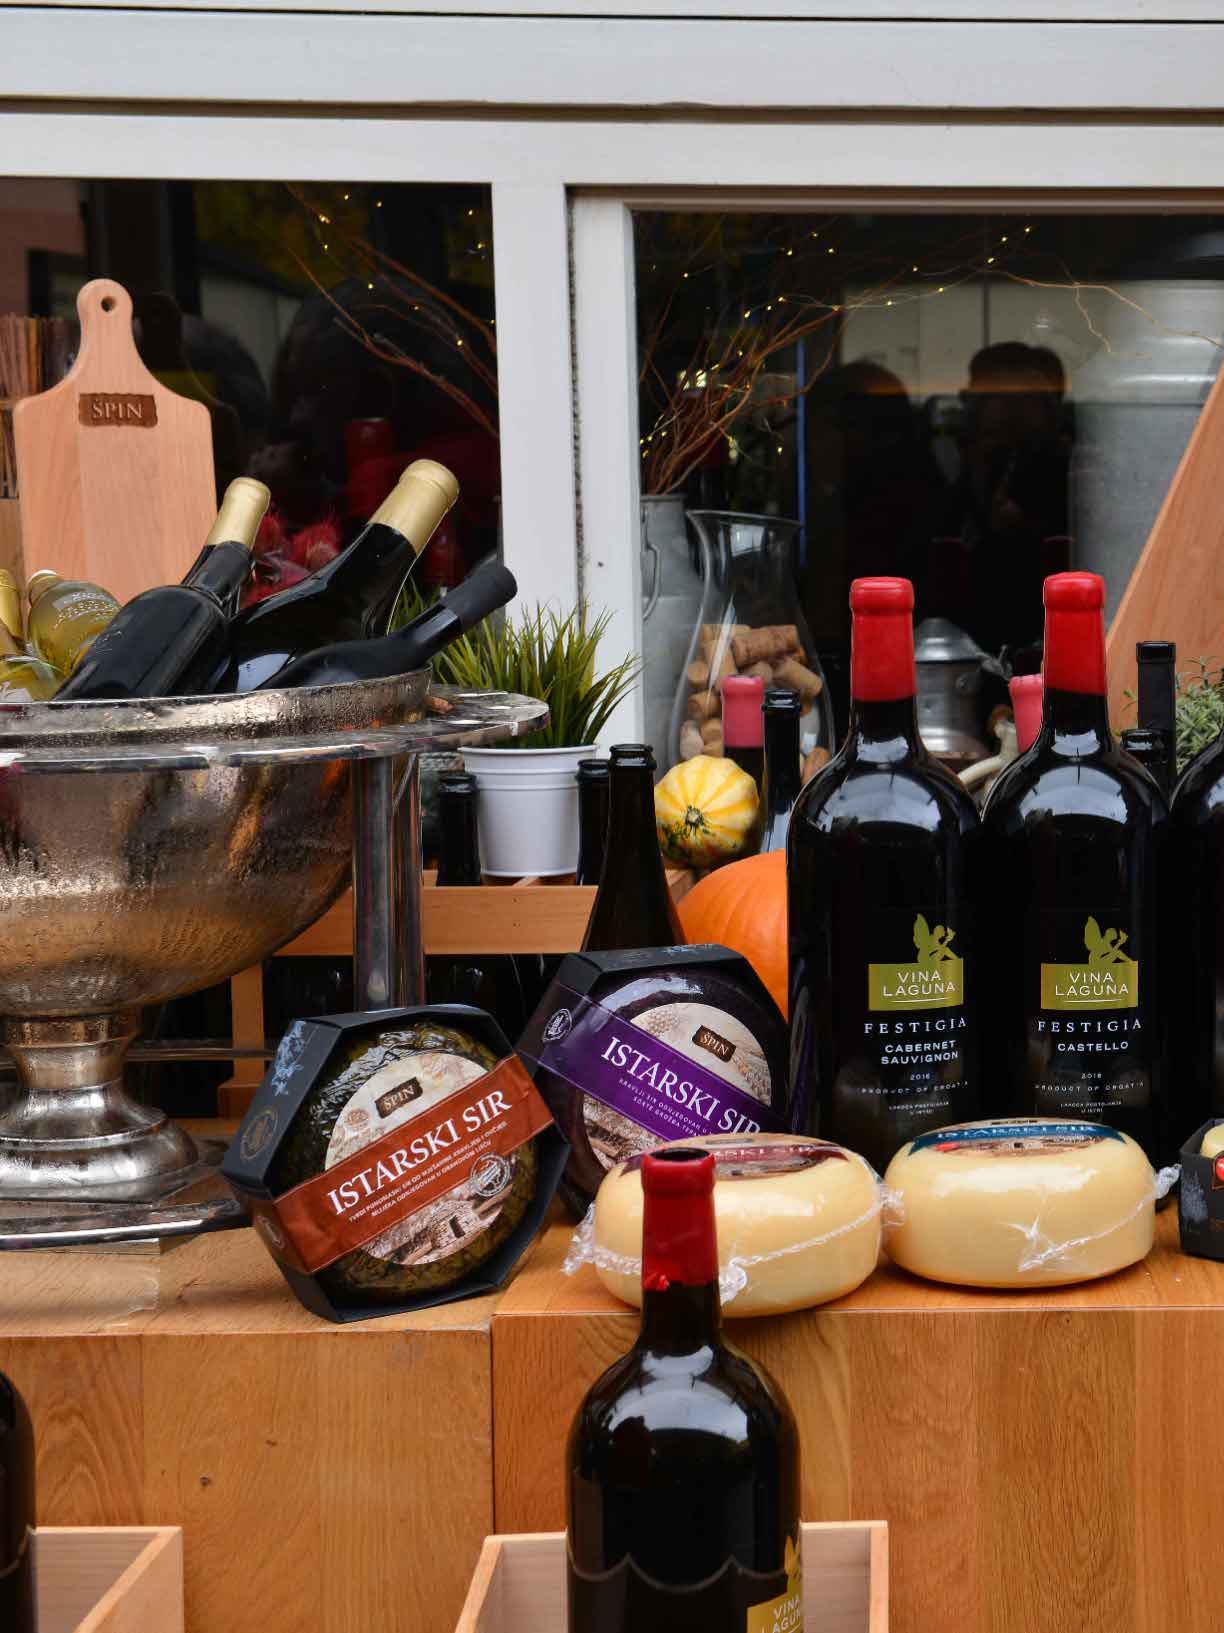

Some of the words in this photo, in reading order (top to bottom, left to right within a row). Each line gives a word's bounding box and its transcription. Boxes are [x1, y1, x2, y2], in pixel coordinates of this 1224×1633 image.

[898, 970, 942, 984] VINA
[1069, 972, 1114, 984] VINA
[883, 981, 956, 997] LAGUNA
[1055, 983, 1129, 996] LAGUNA
[864, 1017, 967, 1034] FESTIGIA
[1037, 1019, 1142, 1033] FESTIGIA
[884, 1040, 956, 1053] CABERNET
[1057, 1041, 1129, 1052] CASTELLO
[881, 1051, 959, 1065] SAUVIGNON
[601, 1036, 721, 1121] ISTARSKI
[327, 1117, 463, 1215] ISTARSKI
[462, 1090, 512, 1132] SIR
